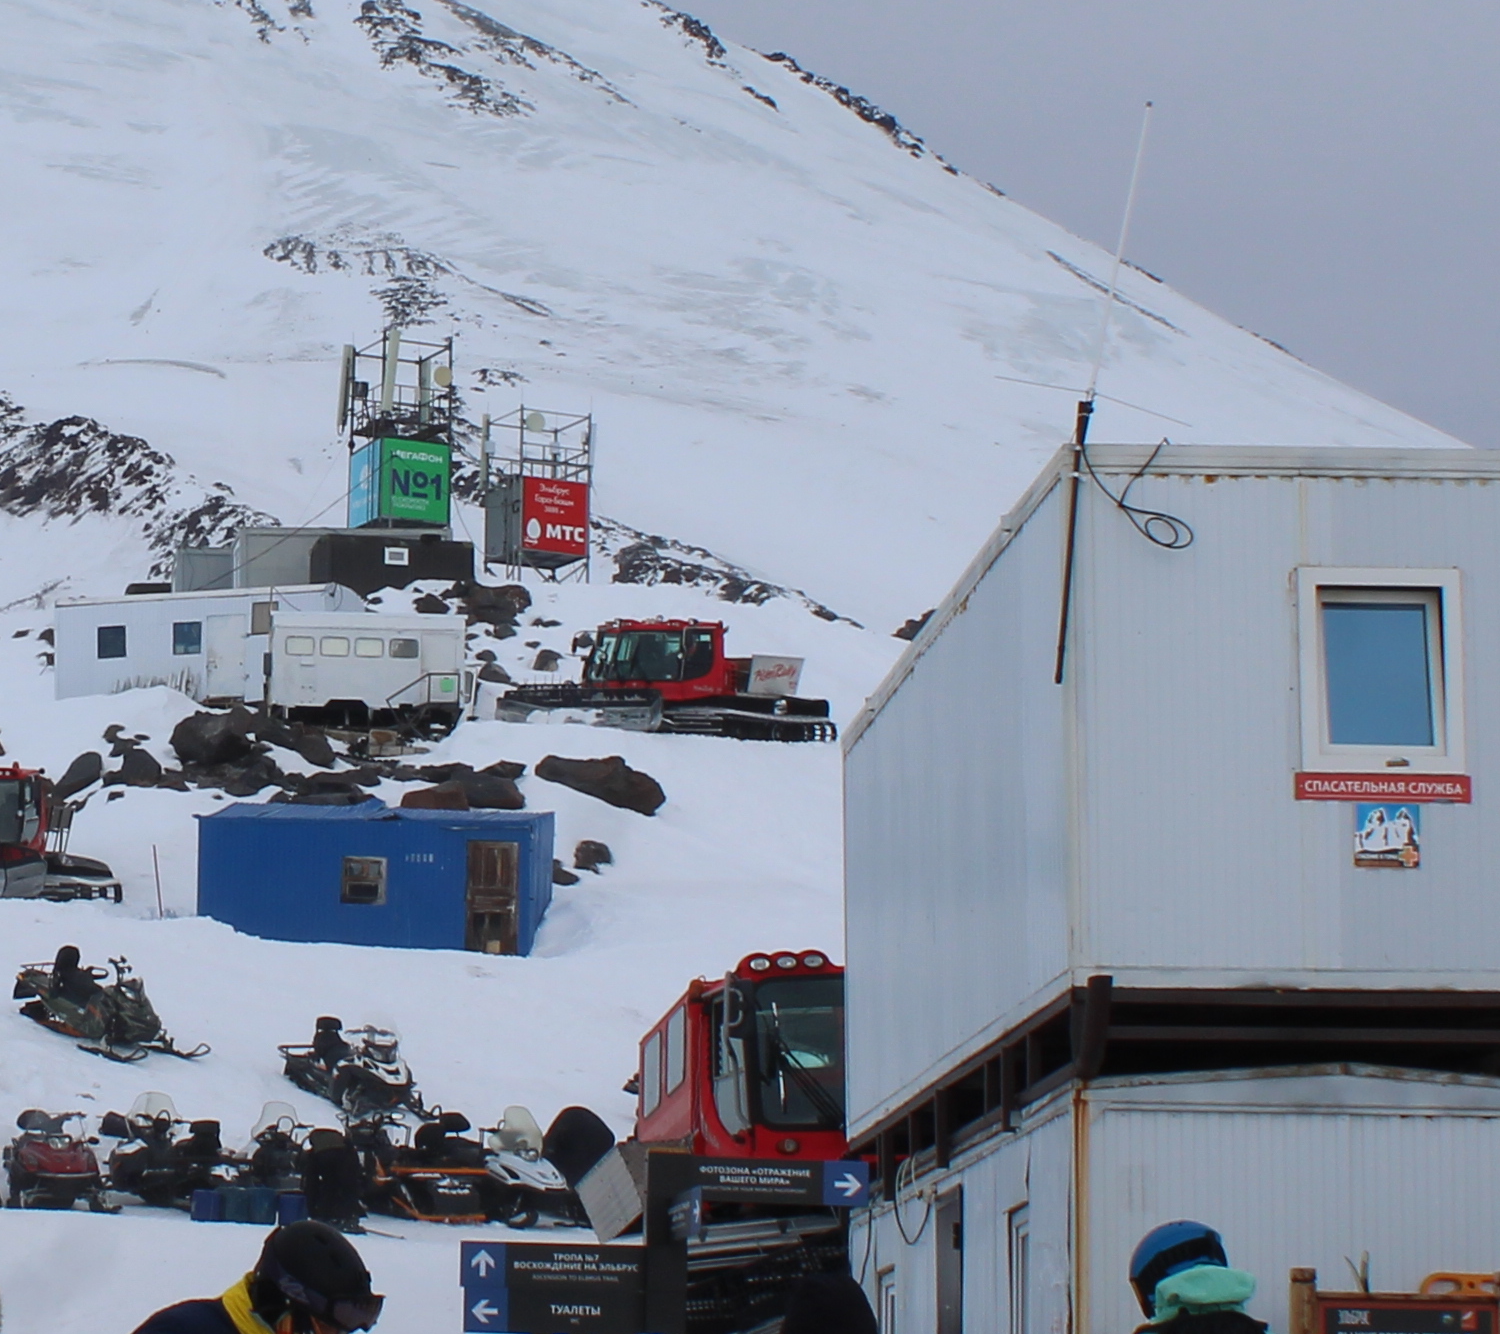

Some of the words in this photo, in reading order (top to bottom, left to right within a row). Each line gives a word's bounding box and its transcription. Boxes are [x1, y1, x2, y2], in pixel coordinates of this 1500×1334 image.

[392, 468, 442, 501] №1
[545, 523, 585, 543] МТС
[1304, 779, 1405, 794] СПАСАТЕЛЬНАЯ
[1408, 782, 1463, 795] СЛУЖБА
[699, 1166, 751, 1177] ФОТОЗОНА
[752, 1167, 811, 1178] «ОТРАЖЕНИЕ
[719, 1175, 758, 1185] ВАШЕГО
[759, 1177, 791, 1186] МИРА»
[553, 1252, 584, 1263] ТРОПА
[513, 1260, 583, 1272] ВОСХОЖДЕНИЕ
[584, 1262, 598, 1272] НА
[599, 1263, 640, 1274] ЭЛЬБРУС
[550, 1304, 601, 1317] ТУАЛЕТЫ
